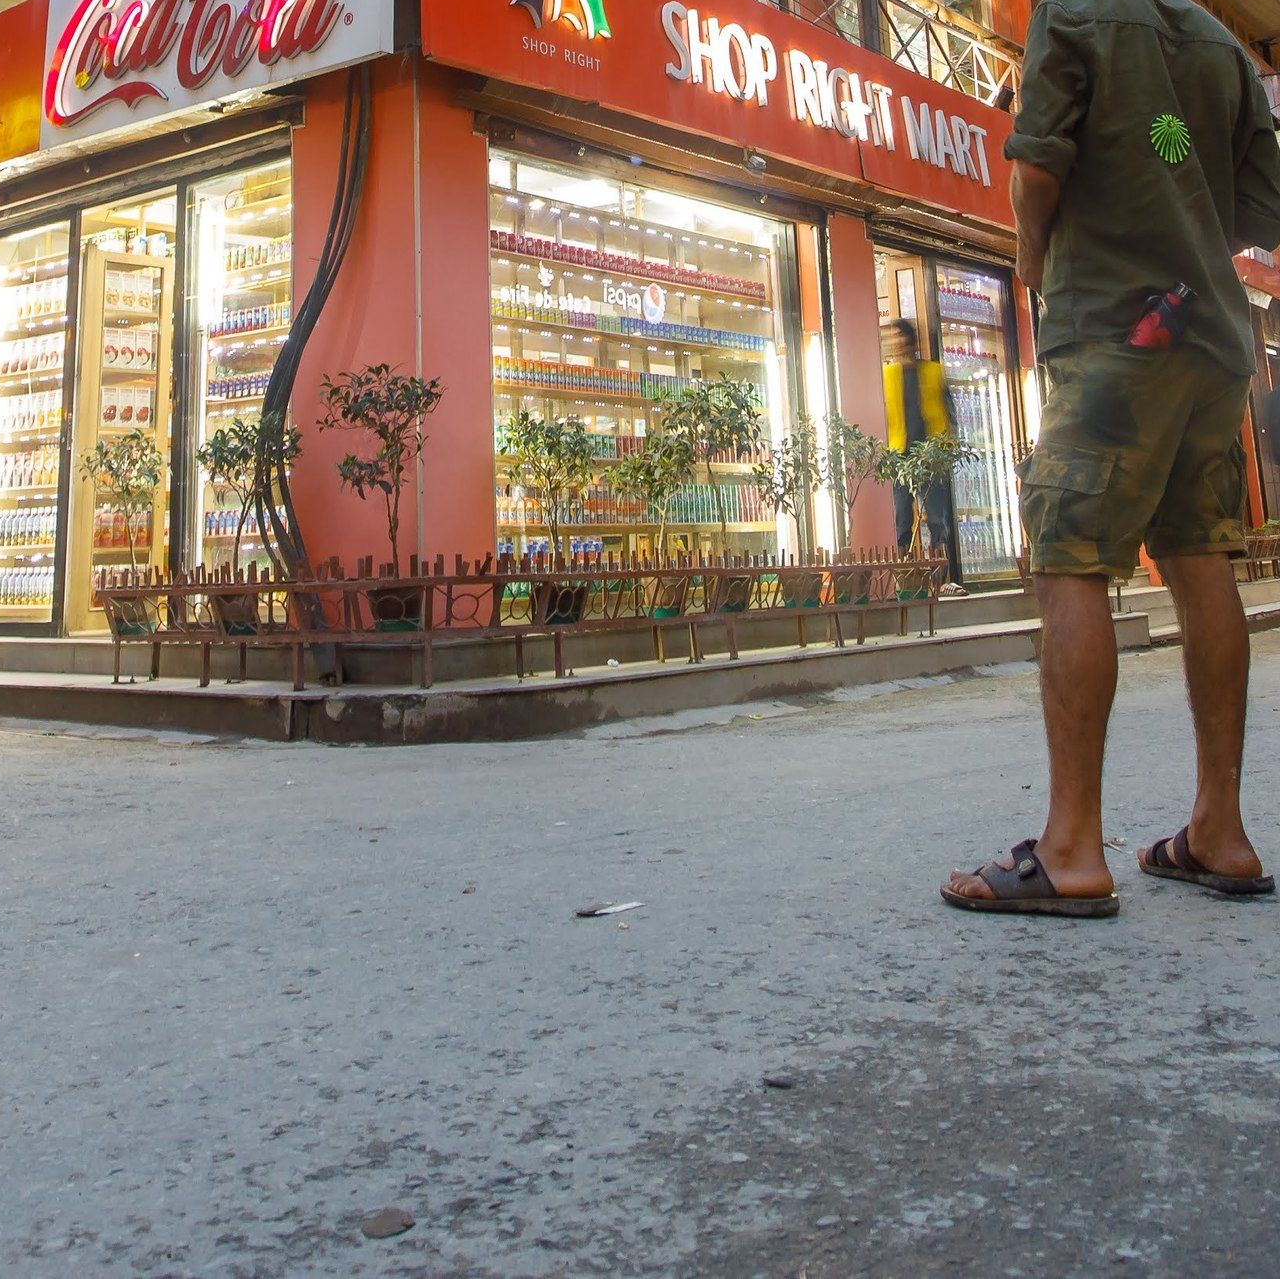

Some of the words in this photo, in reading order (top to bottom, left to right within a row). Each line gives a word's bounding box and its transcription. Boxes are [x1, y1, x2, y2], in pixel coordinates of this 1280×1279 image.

[521, 34, 557, 58] SHOP
[563, 47, 602, 73] RIGHT
[661, 0, 778, 108] SHOP
[784, 48, 896, 153] RIGHT
[901, 96, 992, 188] MART
